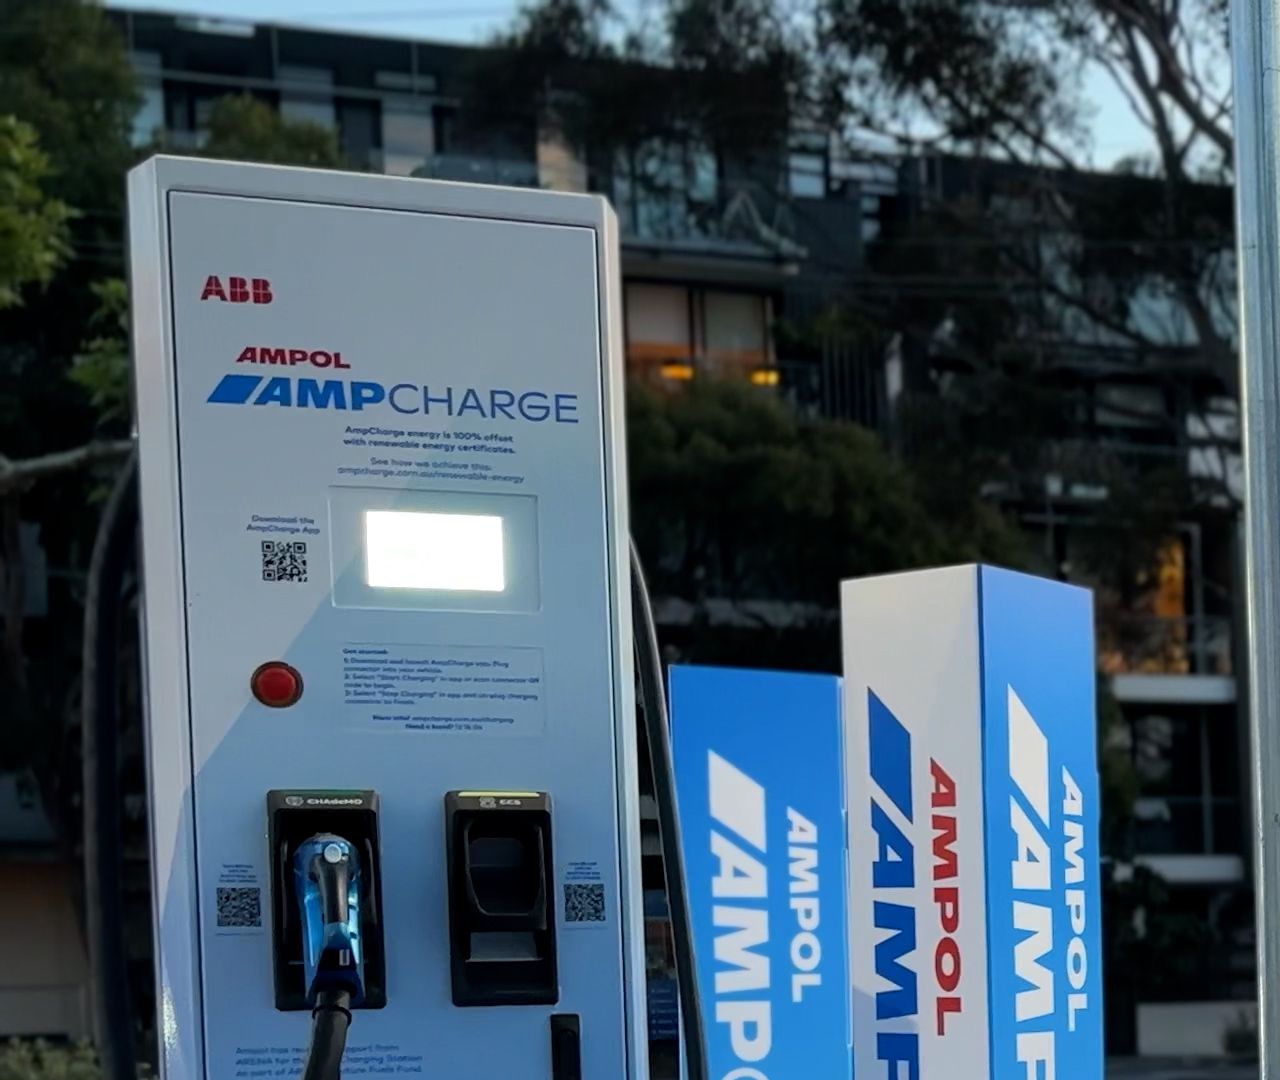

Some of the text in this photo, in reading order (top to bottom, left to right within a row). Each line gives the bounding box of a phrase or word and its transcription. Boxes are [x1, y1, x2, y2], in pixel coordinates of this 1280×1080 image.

[200, 275, 274, 304] ABB
[236, 346, 351, 369] AMPOL
[253, 376, 580, 424] AMPCHARGE
[368, 440, 419, 448] renewable
[422, 443, 456, 453] energy
[407, 431, 441, 440] energy
[786, 805, 822, 1003] AMPOL
[929, 756, 962, 1037] AMPOL
[1062, 764, 1088, 1032] AMPOL
